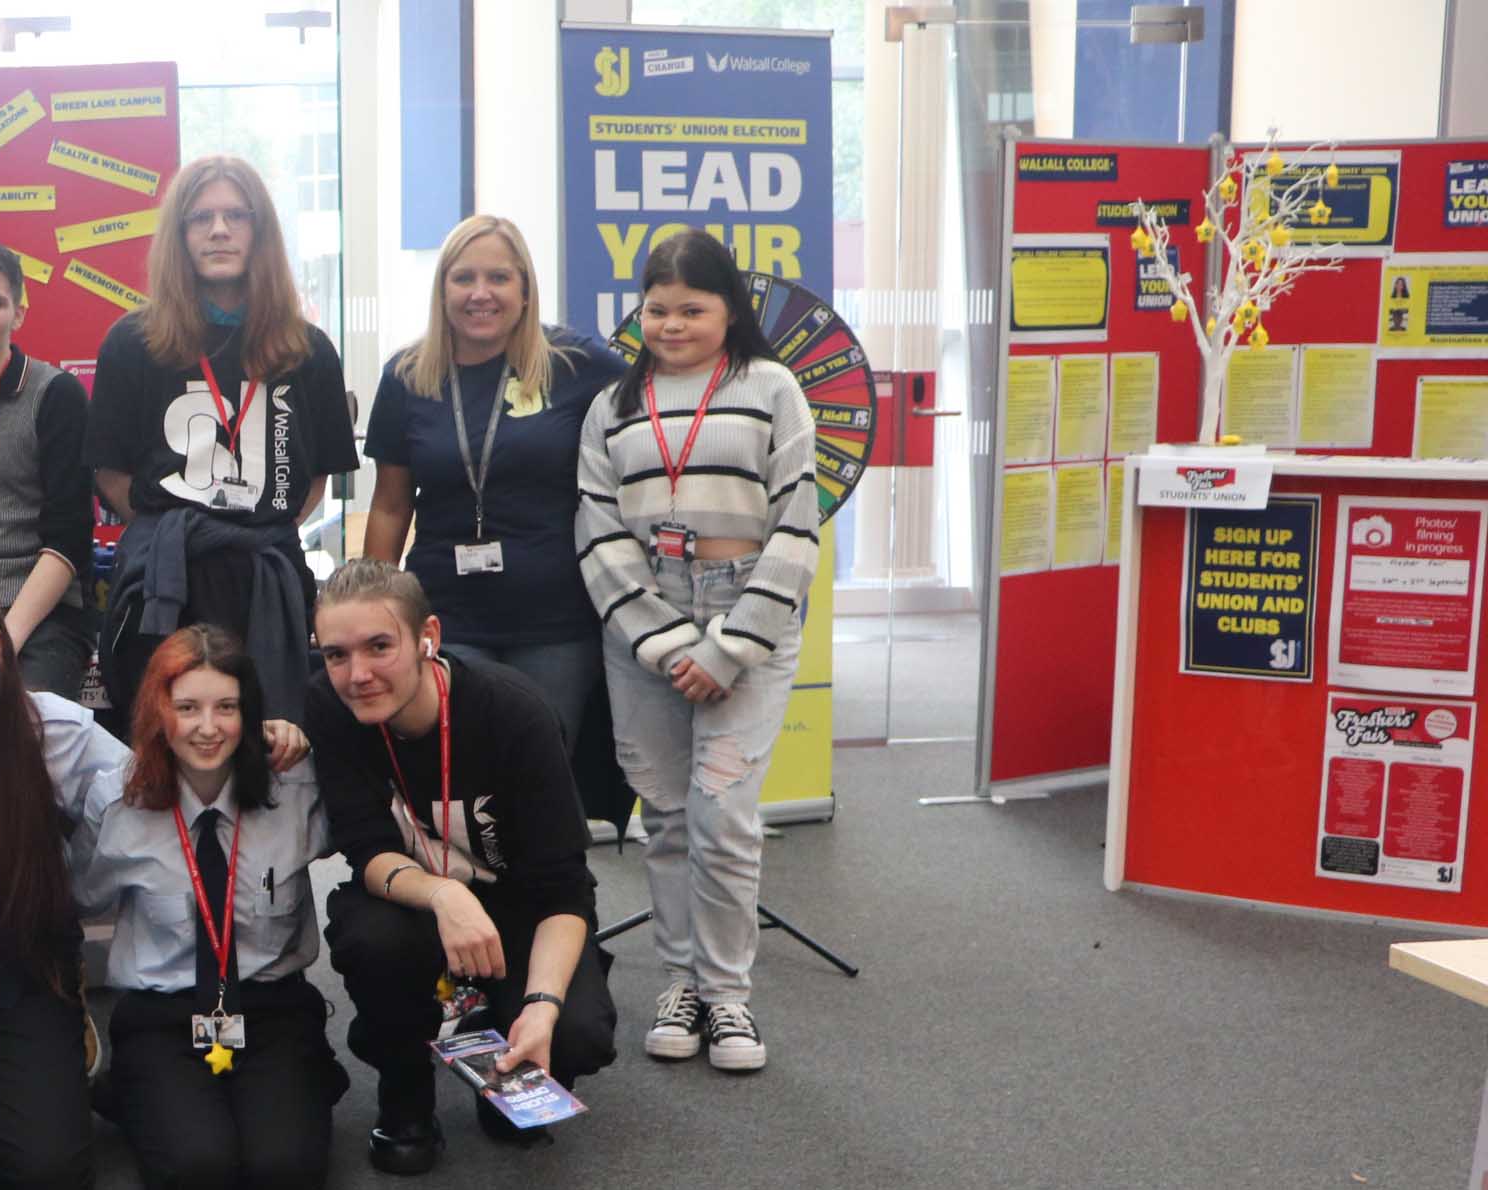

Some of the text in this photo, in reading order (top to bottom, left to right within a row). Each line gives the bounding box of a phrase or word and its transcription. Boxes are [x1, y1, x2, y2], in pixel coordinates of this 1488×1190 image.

[647, 61, 686, 73] CHANGE
[730, 55, 811, 76] Walsall College
[55, 96, 162, 111] GREEN LANE CAMPUS
[595, 123, 800, 137] STUDENTS' UNION ELECTION
[53, 143, 157, 183] HEALTH & WELLBEING
[1019, 157, 1110, 171] WALSALL COLLEGE
[595, 150, 802, 212] LEAD
[92, 221, 129, 235] LGBTQ+
[74, 266, 125, 296] WISEMORE
[1138, 295, 1173, 307] UNION
[822, 411, 851, 421] SPIN
[273, 412, 295, 464] Walsall
[1160, 489, 1246, 501] STUDENTS' UNION
[1416, 517, 1458, 529] Photos/
[1214, 527, 1293, 545] SIGN UP
[1416, 528, 1454, 543] filming
[1406, 542, 1464, 556] in progress
[1205, 549, 1301, 568] HERE FOR
[1200, 571, 1303, 590] STUDENTS'
[1197, 593, 1305, 613] UNION AND
[1218, 616, 1280, 635] CLUBS
[1337, 707, 1416, 730] Freshers'
[1347, 726, 1389, 747] Fair
